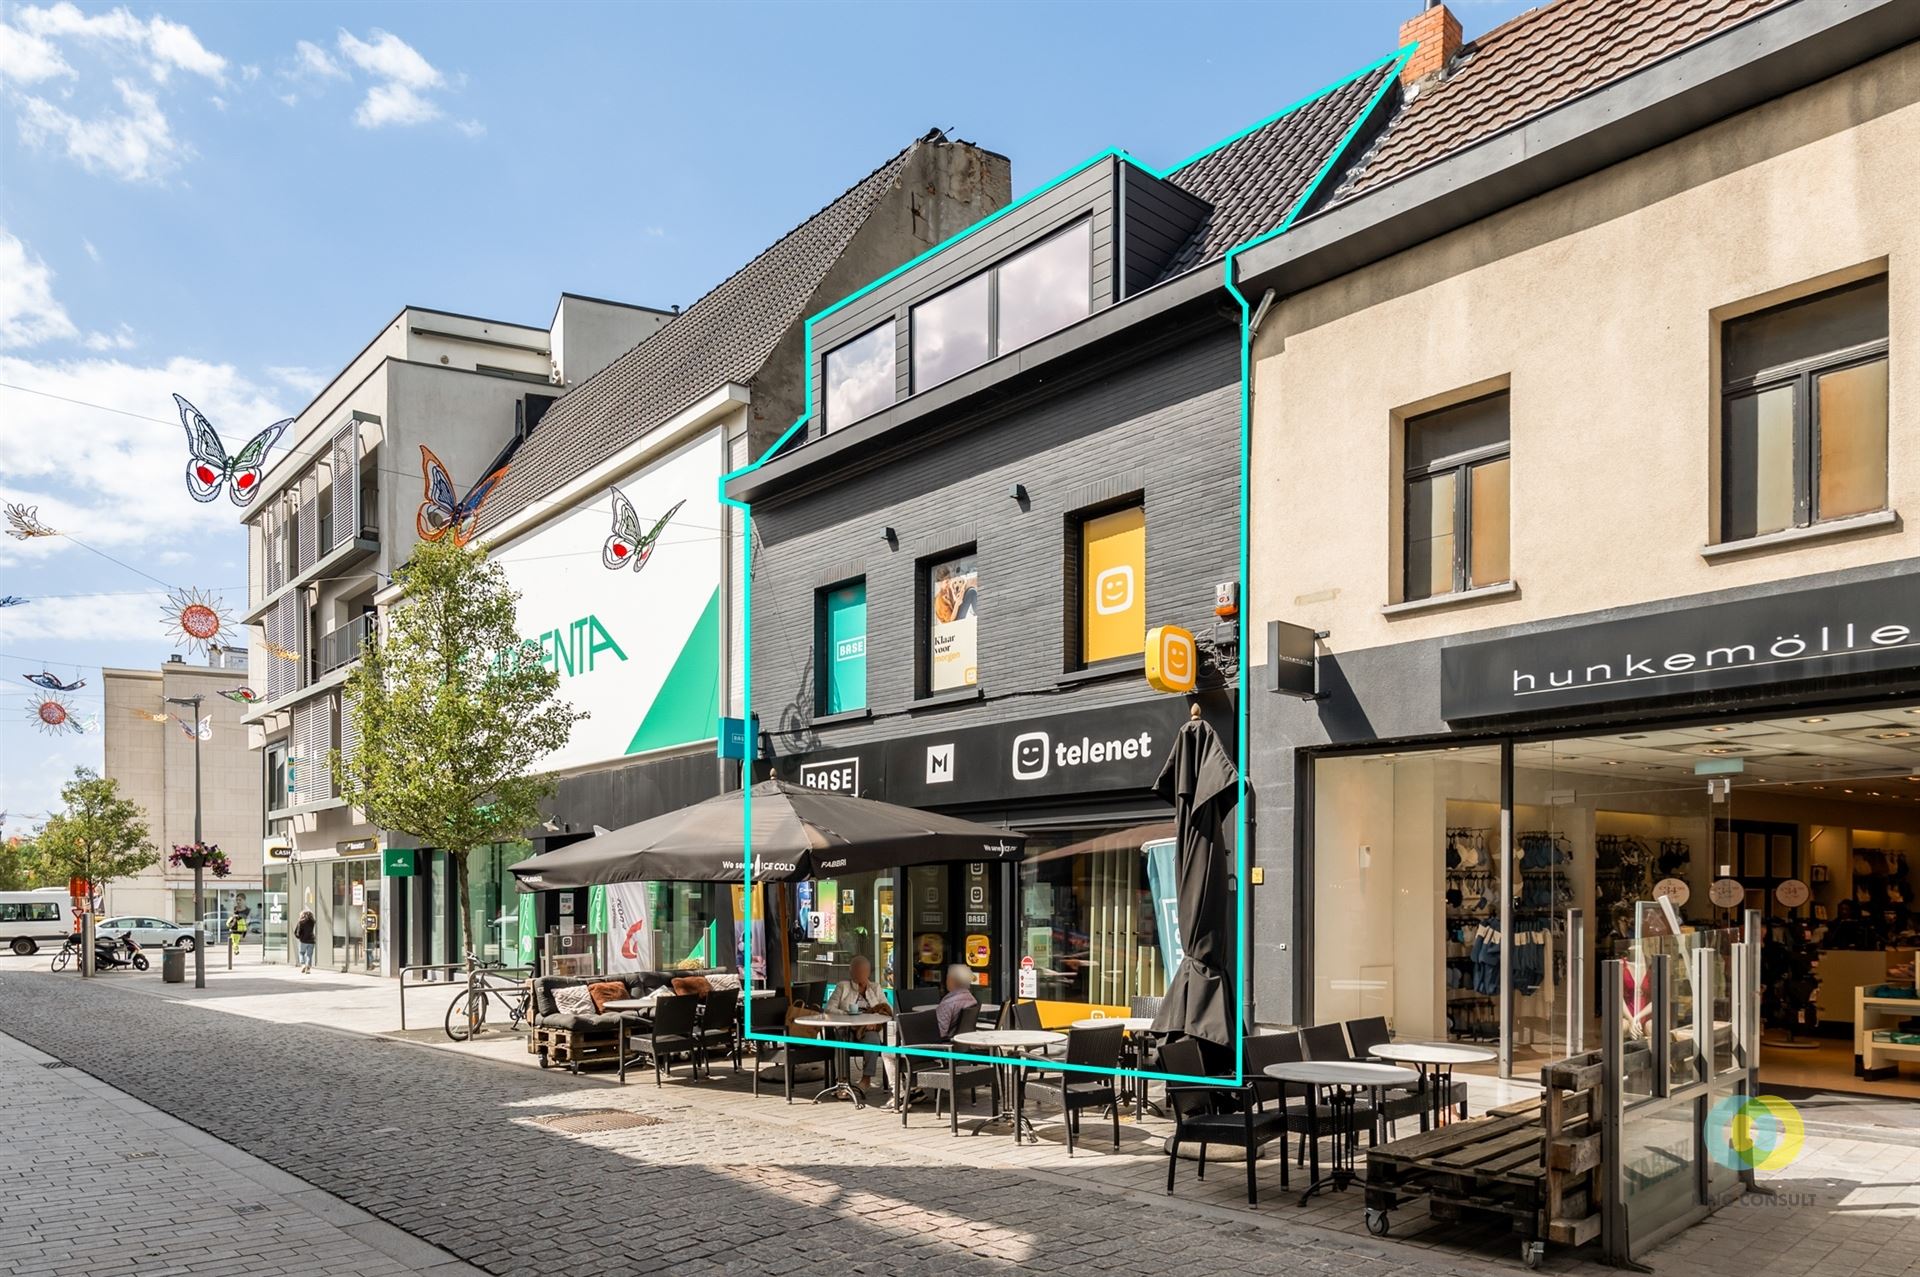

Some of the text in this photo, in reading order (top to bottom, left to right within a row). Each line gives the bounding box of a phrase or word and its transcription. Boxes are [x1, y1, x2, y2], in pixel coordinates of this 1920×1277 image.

[934, 634, 955, 646] Klaar
[839, 640, 864, 657] BASE
[934, 645, 951, 654] voor
[1055, 731, 1152, 767] telenet
[931, 752, 949, 774] M
[806, 767, 853, 791] BASE
[722, 860, 734, 869] We
[761, 862, 773, 870] ICE
[774, 862, 796, 871] COLD
[820, 858, 847, 869] FABBRI
[968, 915, 985, 923] BASE
